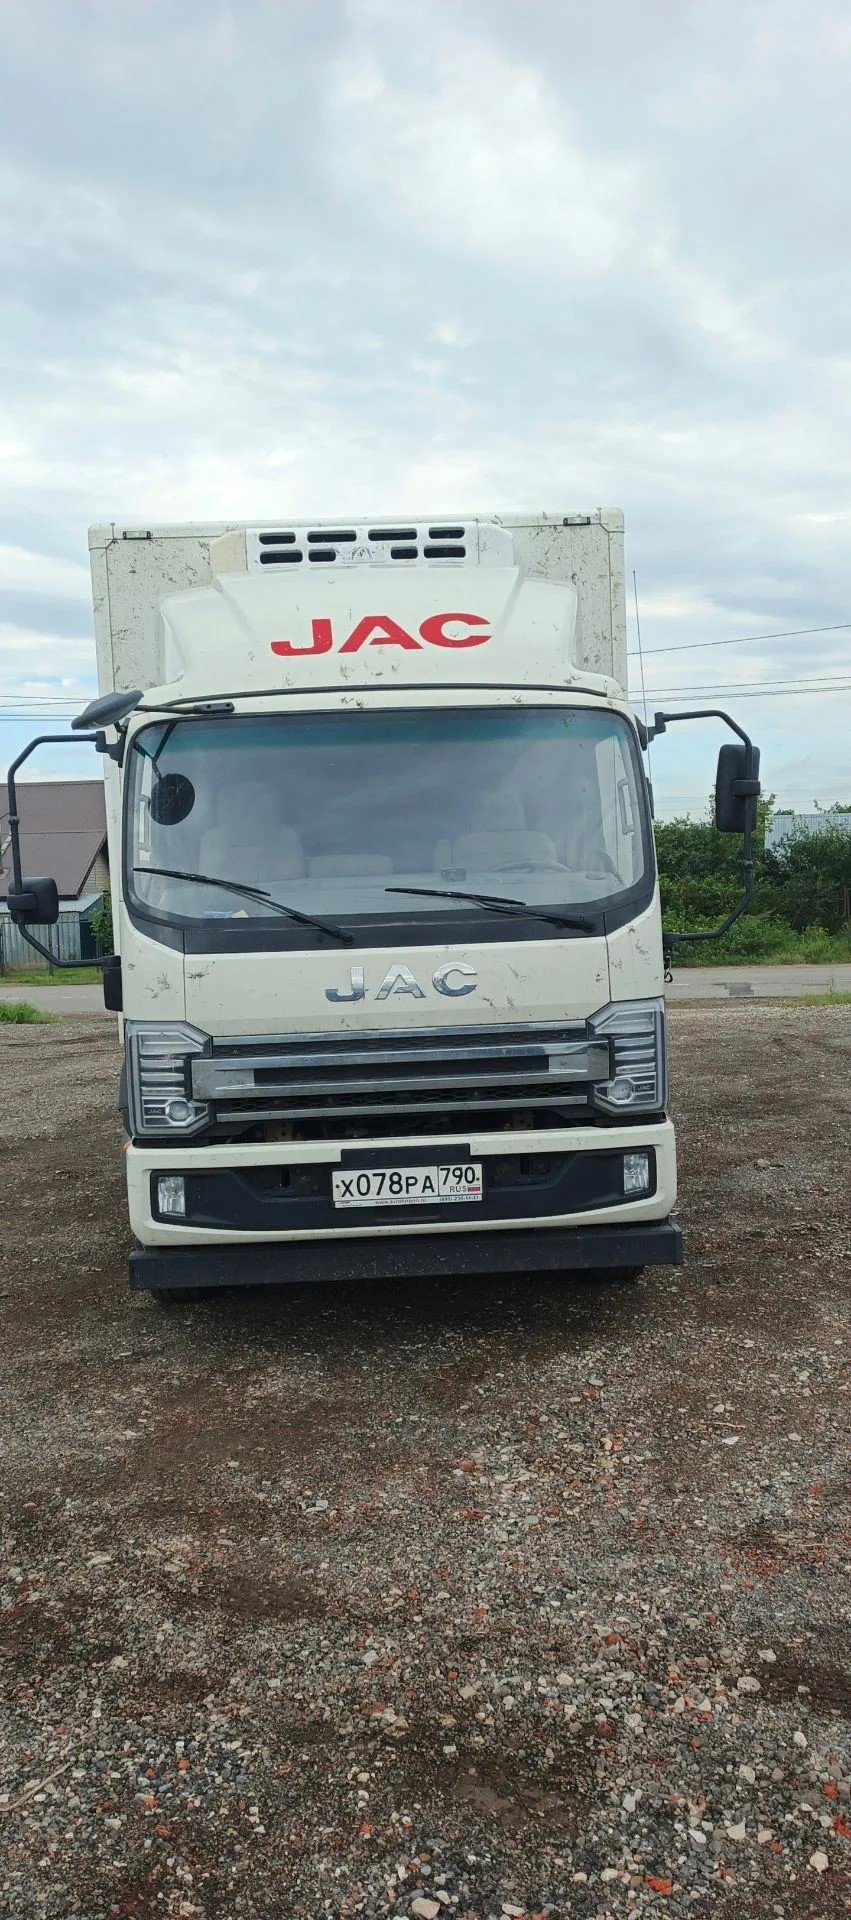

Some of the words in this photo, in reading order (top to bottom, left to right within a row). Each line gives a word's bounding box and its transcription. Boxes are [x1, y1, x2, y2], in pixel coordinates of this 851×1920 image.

[270, 612, 493, 657] JAC
[325, 961, 478, 1003] JAC
[439, 1166, 476, 1186] 790
[449, 1185, 467, 1194] RUS
